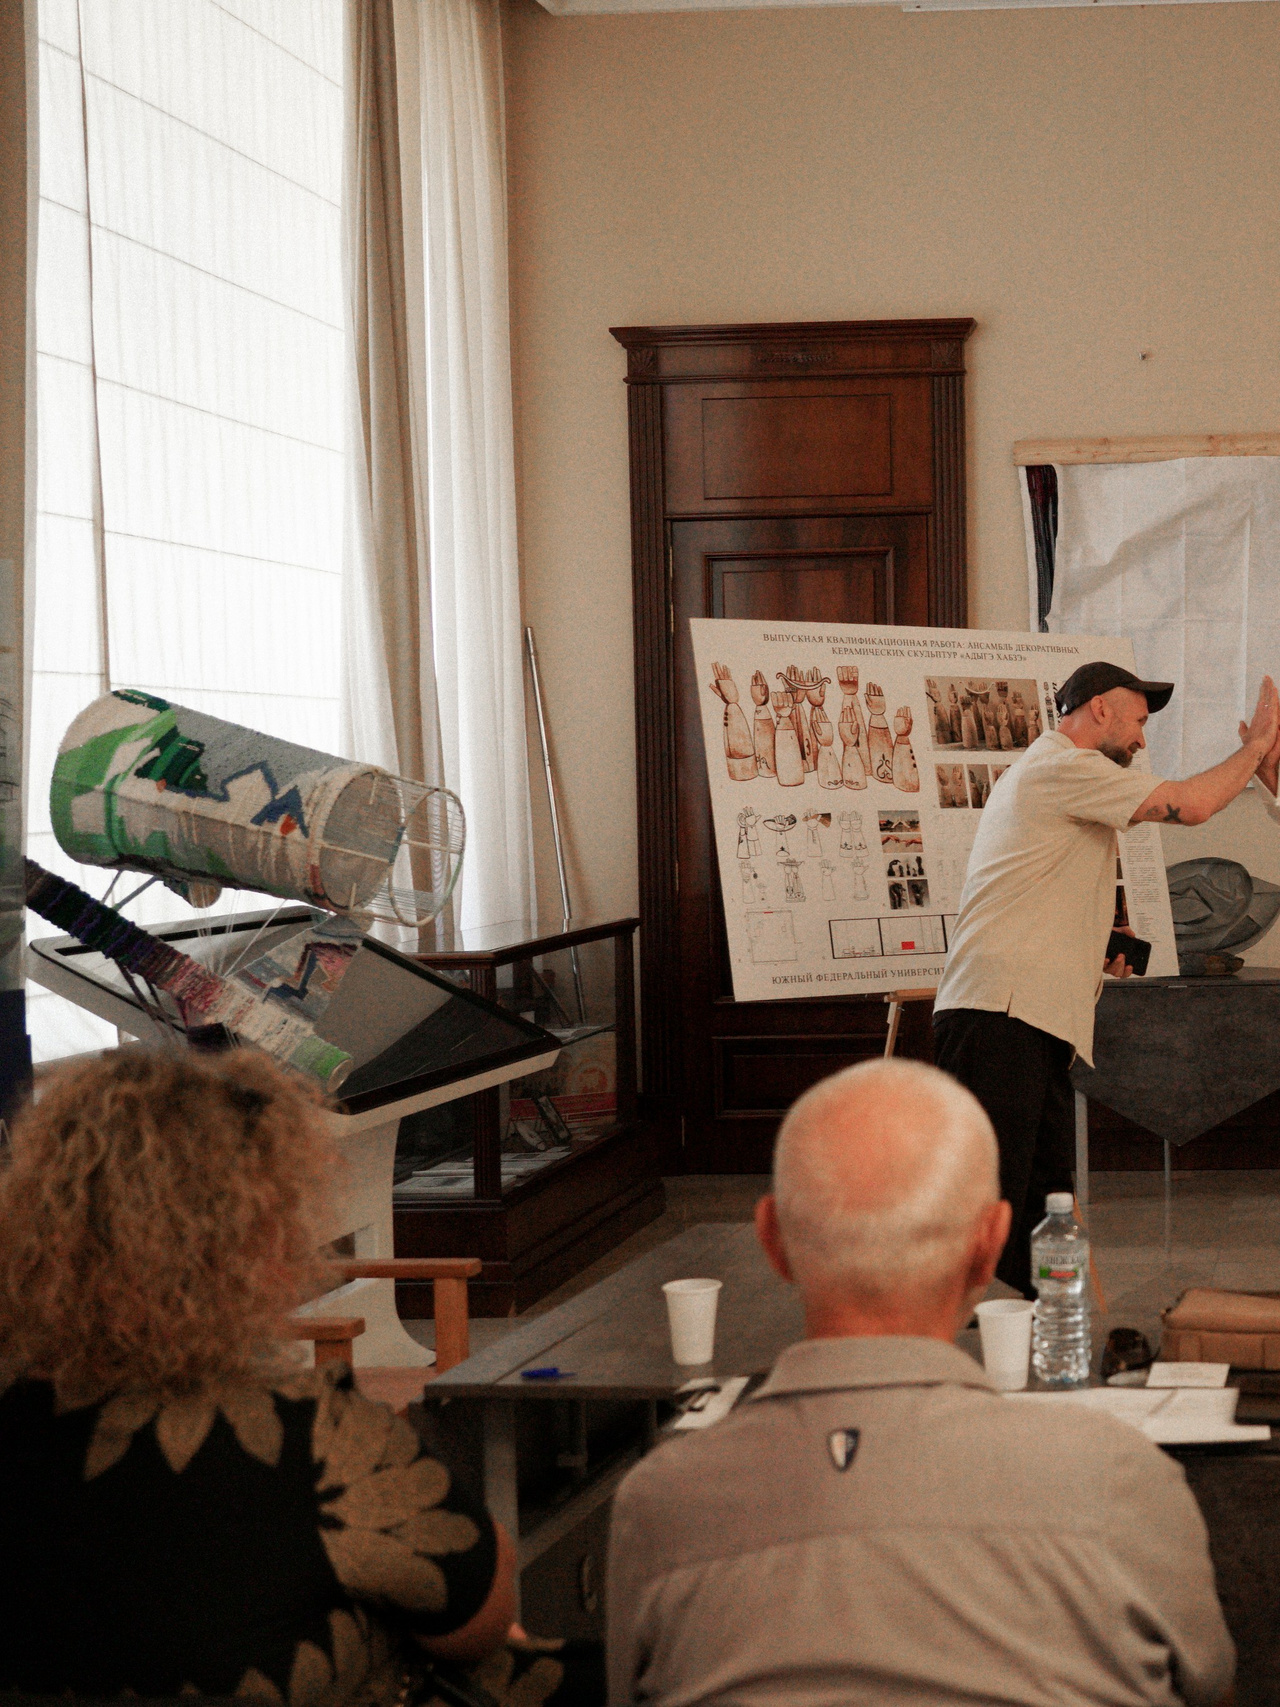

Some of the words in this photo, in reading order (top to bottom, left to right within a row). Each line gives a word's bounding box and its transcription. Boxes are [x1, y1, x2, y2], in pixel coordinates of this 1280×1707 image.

[763, 633, 824, 643] ВЫПУСКНАЯ
[826, 636, 928, 647] КВАЛИФИКАЦИОННАЯ
[930, 640, 965, 649] РАБОТА:
[967, 642, 1013, 651] АНСАМБЛЬ
[1015, 645, 1080, 654] ДЕКОРАТИВНЫХ
[832, 647, 905, 657] КЕРАМИЧЕСКИХ
[907, 649, 958, 658] СКУЛЬПТУР
[960, 652, 994, 661] «АДЫГЭ
[996, 653, 1027, 662] ХАБЗЭ»
[772, 971, 813, 984] ЮЖНЫЙ
[816, 968, 888, 982] ФЕДЕРАЛЬНЫЙ
